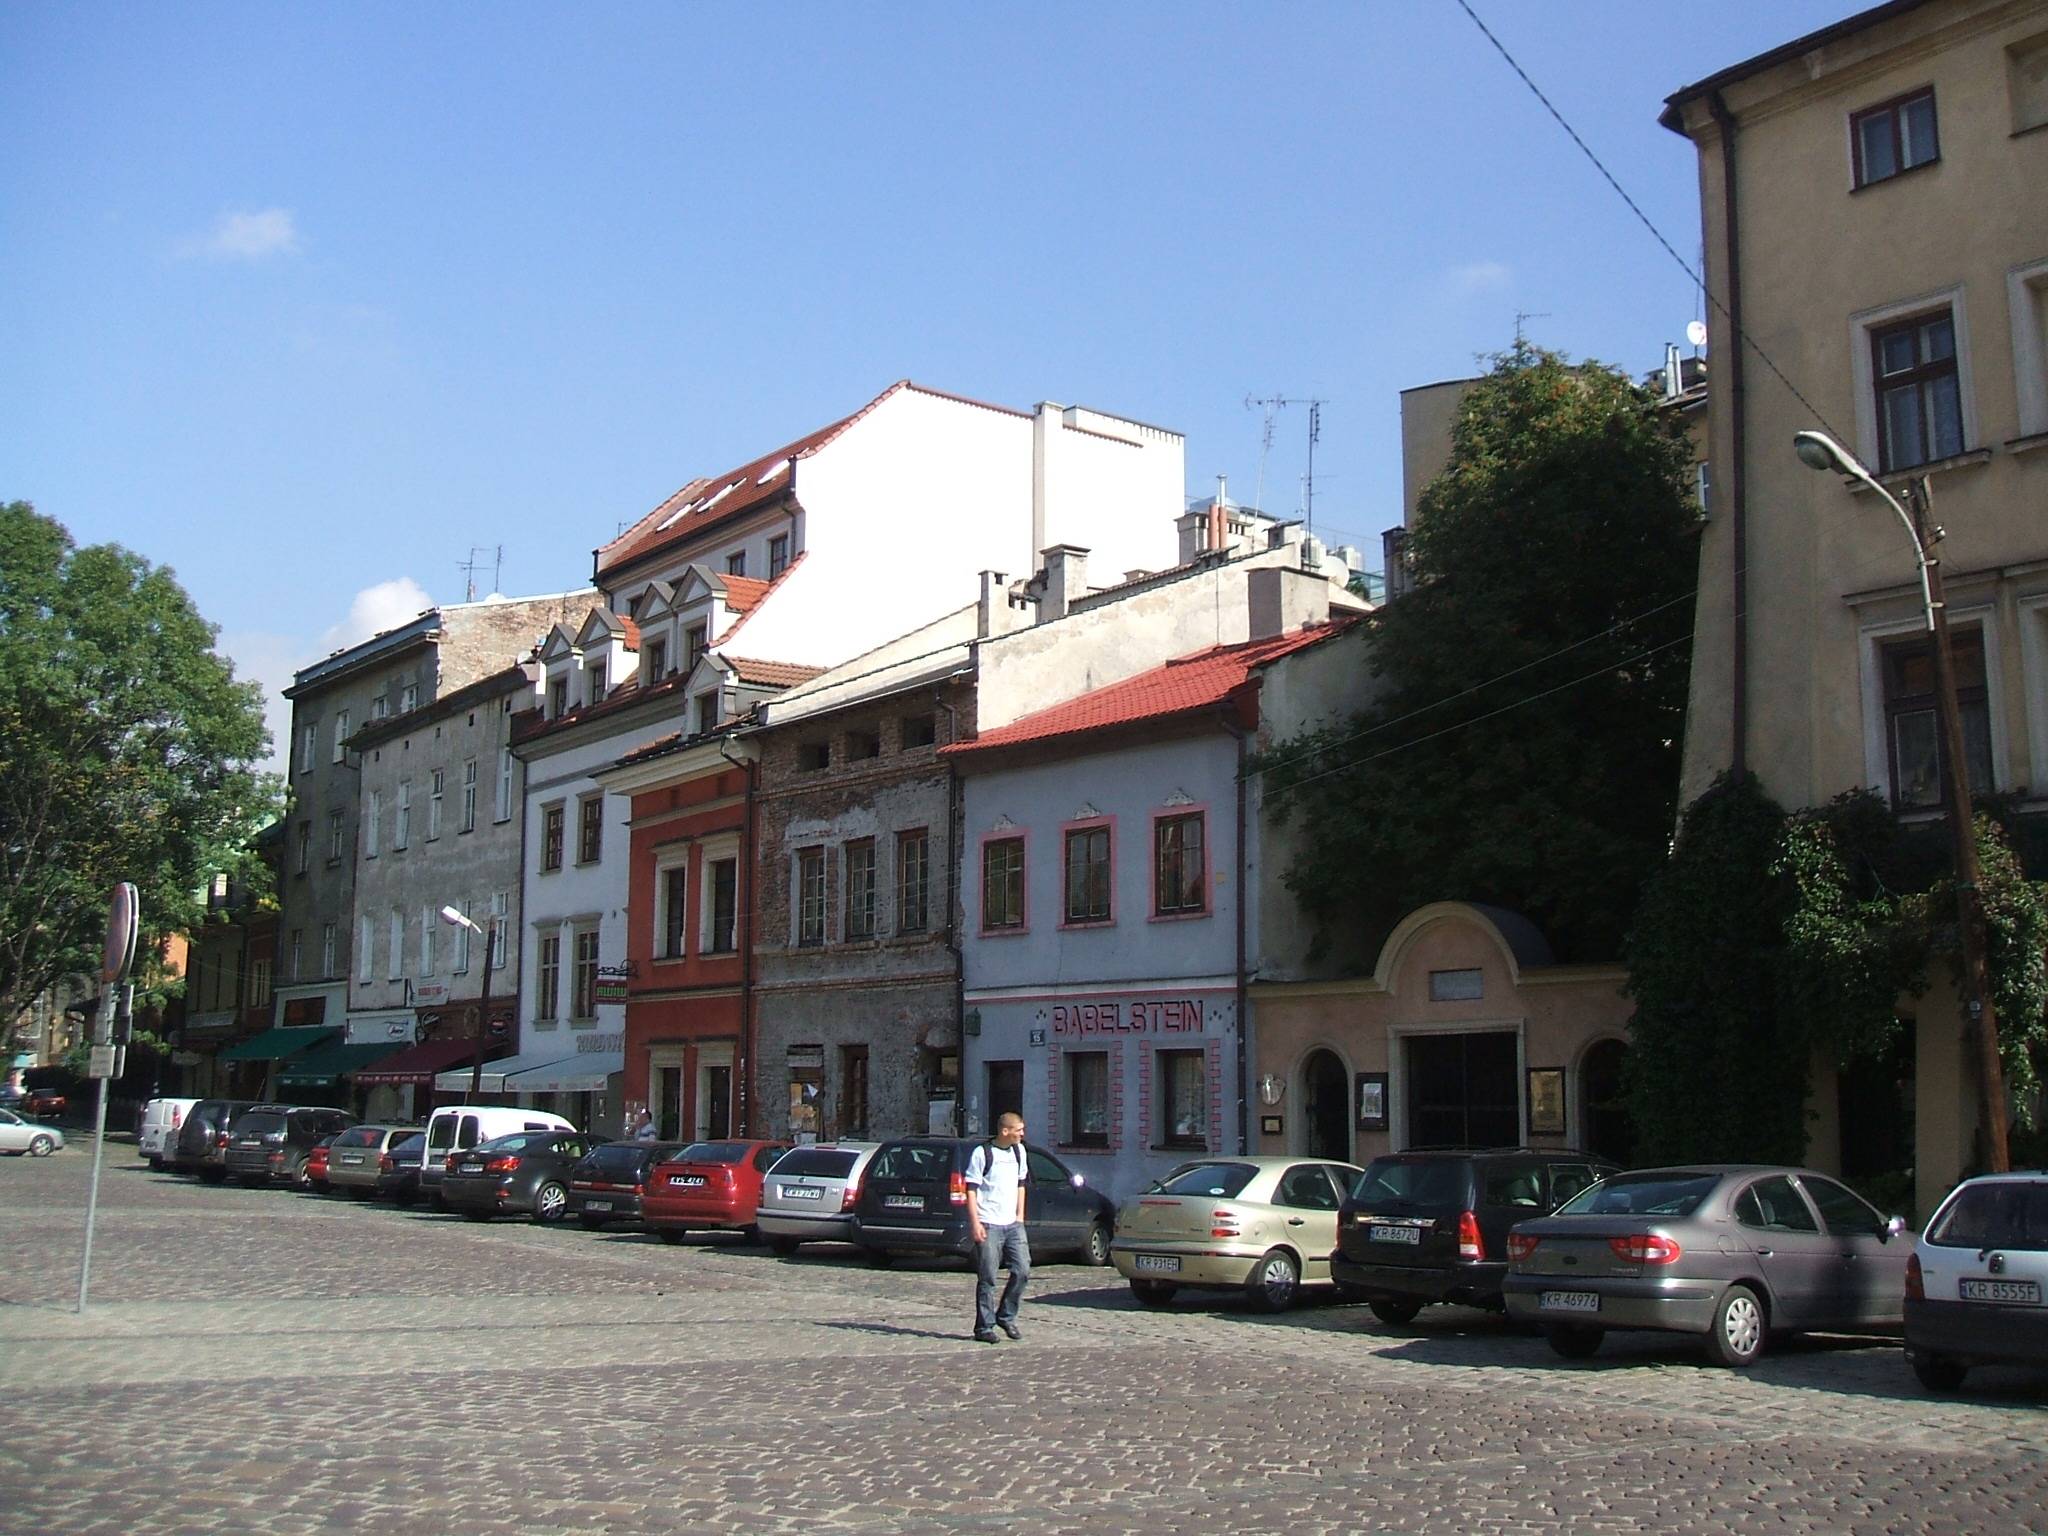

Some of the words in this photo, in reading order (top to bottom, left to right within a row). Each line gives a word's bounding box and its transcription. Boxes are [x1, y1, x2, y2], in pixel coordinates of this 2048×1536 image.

[1053, 1000, 1203, 1036] BABELSTEIN
[1376, 1227, 1389, 1239] KR
[1141, 1257, 1151, 1268] KR
[1968, 1282, 1988, 1298] KR
[1992, 1283, 2035, 1300] 8555F
[1547, 1292, 1561, 1306] KR
[1564, 1292, 1597, 1308] 46976
